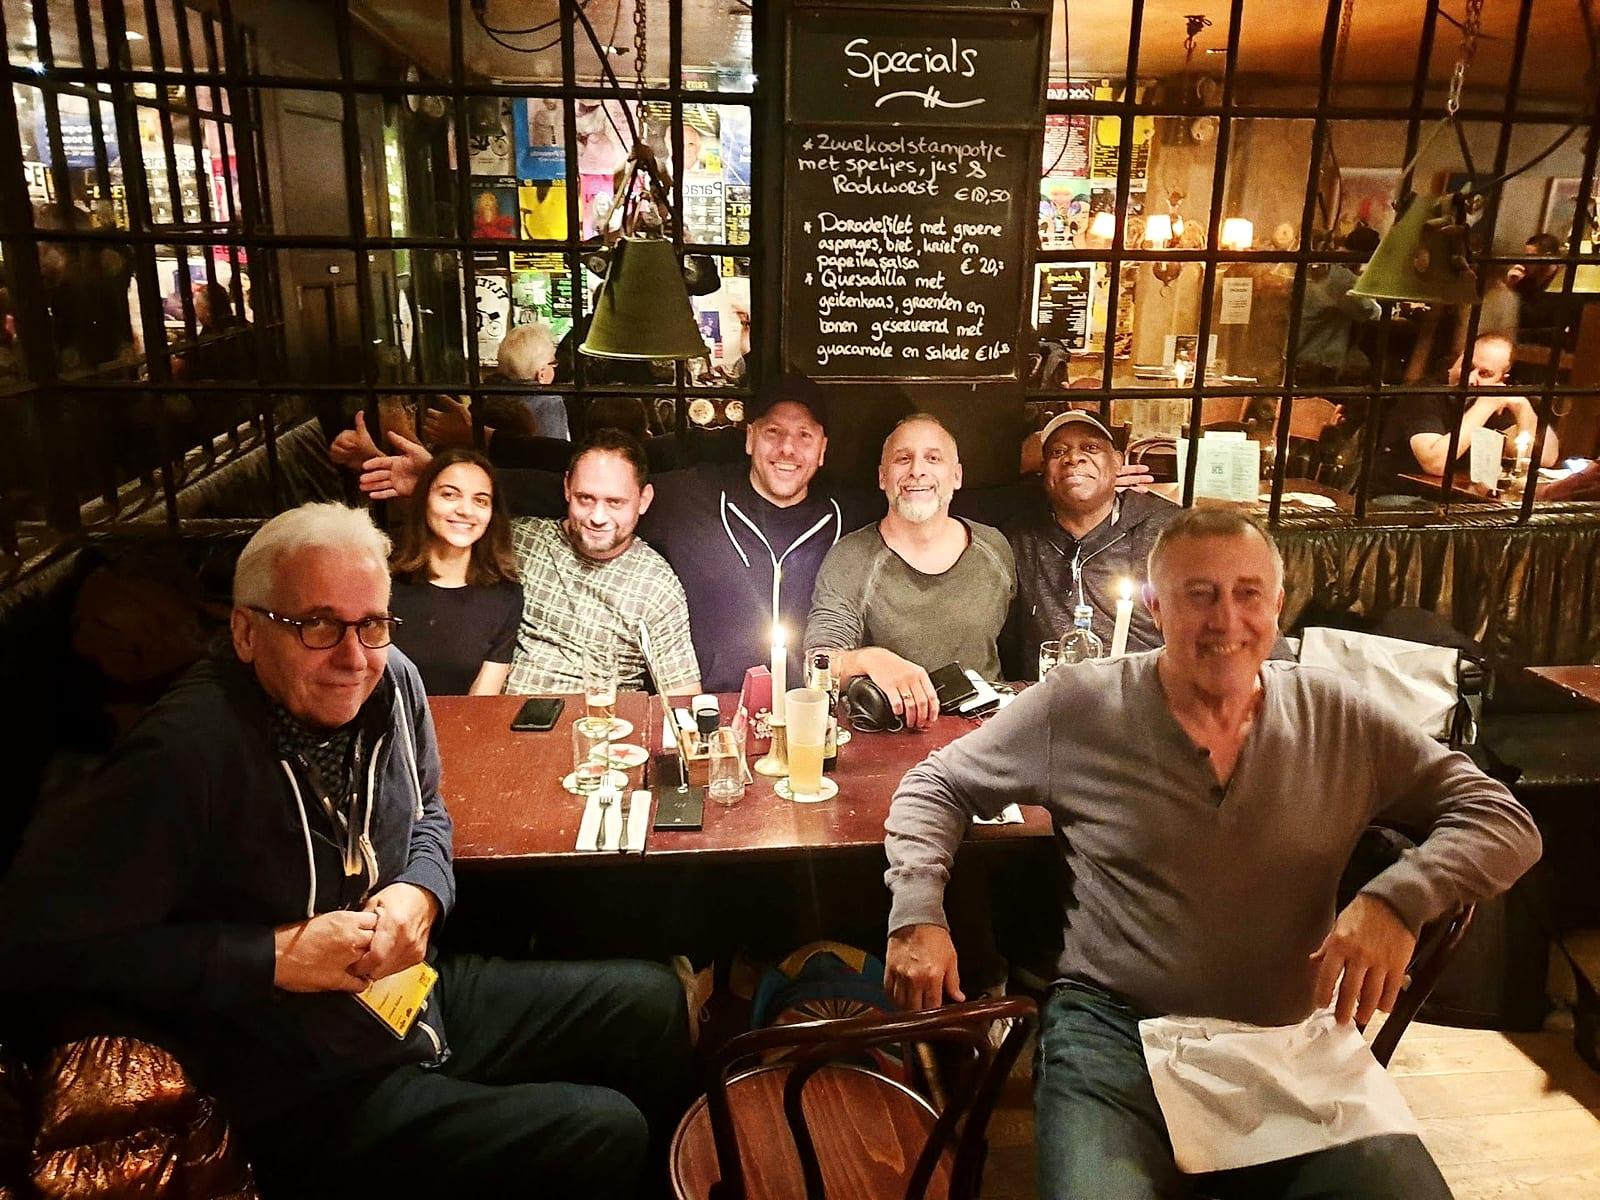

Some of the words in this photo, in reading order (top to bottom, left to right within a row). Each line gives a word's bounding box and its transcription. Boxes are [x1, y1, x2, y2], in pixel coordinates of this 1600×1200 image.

[844, 37, 978, 87] Specials
[798, 155, 840, 171] met
[931, 155, 957, 183] jus
[833, 174, 939, 196] Rookworst
[920, 216, 947, 235] met
[953, 224, 1002, 242] groene
[961, 242, 979, 254] en
[821, 268, 907, 290] Quesadilla
[915, 270, 946, 289] met
[818, 290, 899, 316] geitenkaas,
[902, 291, 963, 316] groenten
[966, 301, 985, 316] en
[818, 317, 858, 334] bonen
[956, 317, 985, 337] met
[816, 341, 894, 365] guacamole
[902, 346, 920, 358] en
